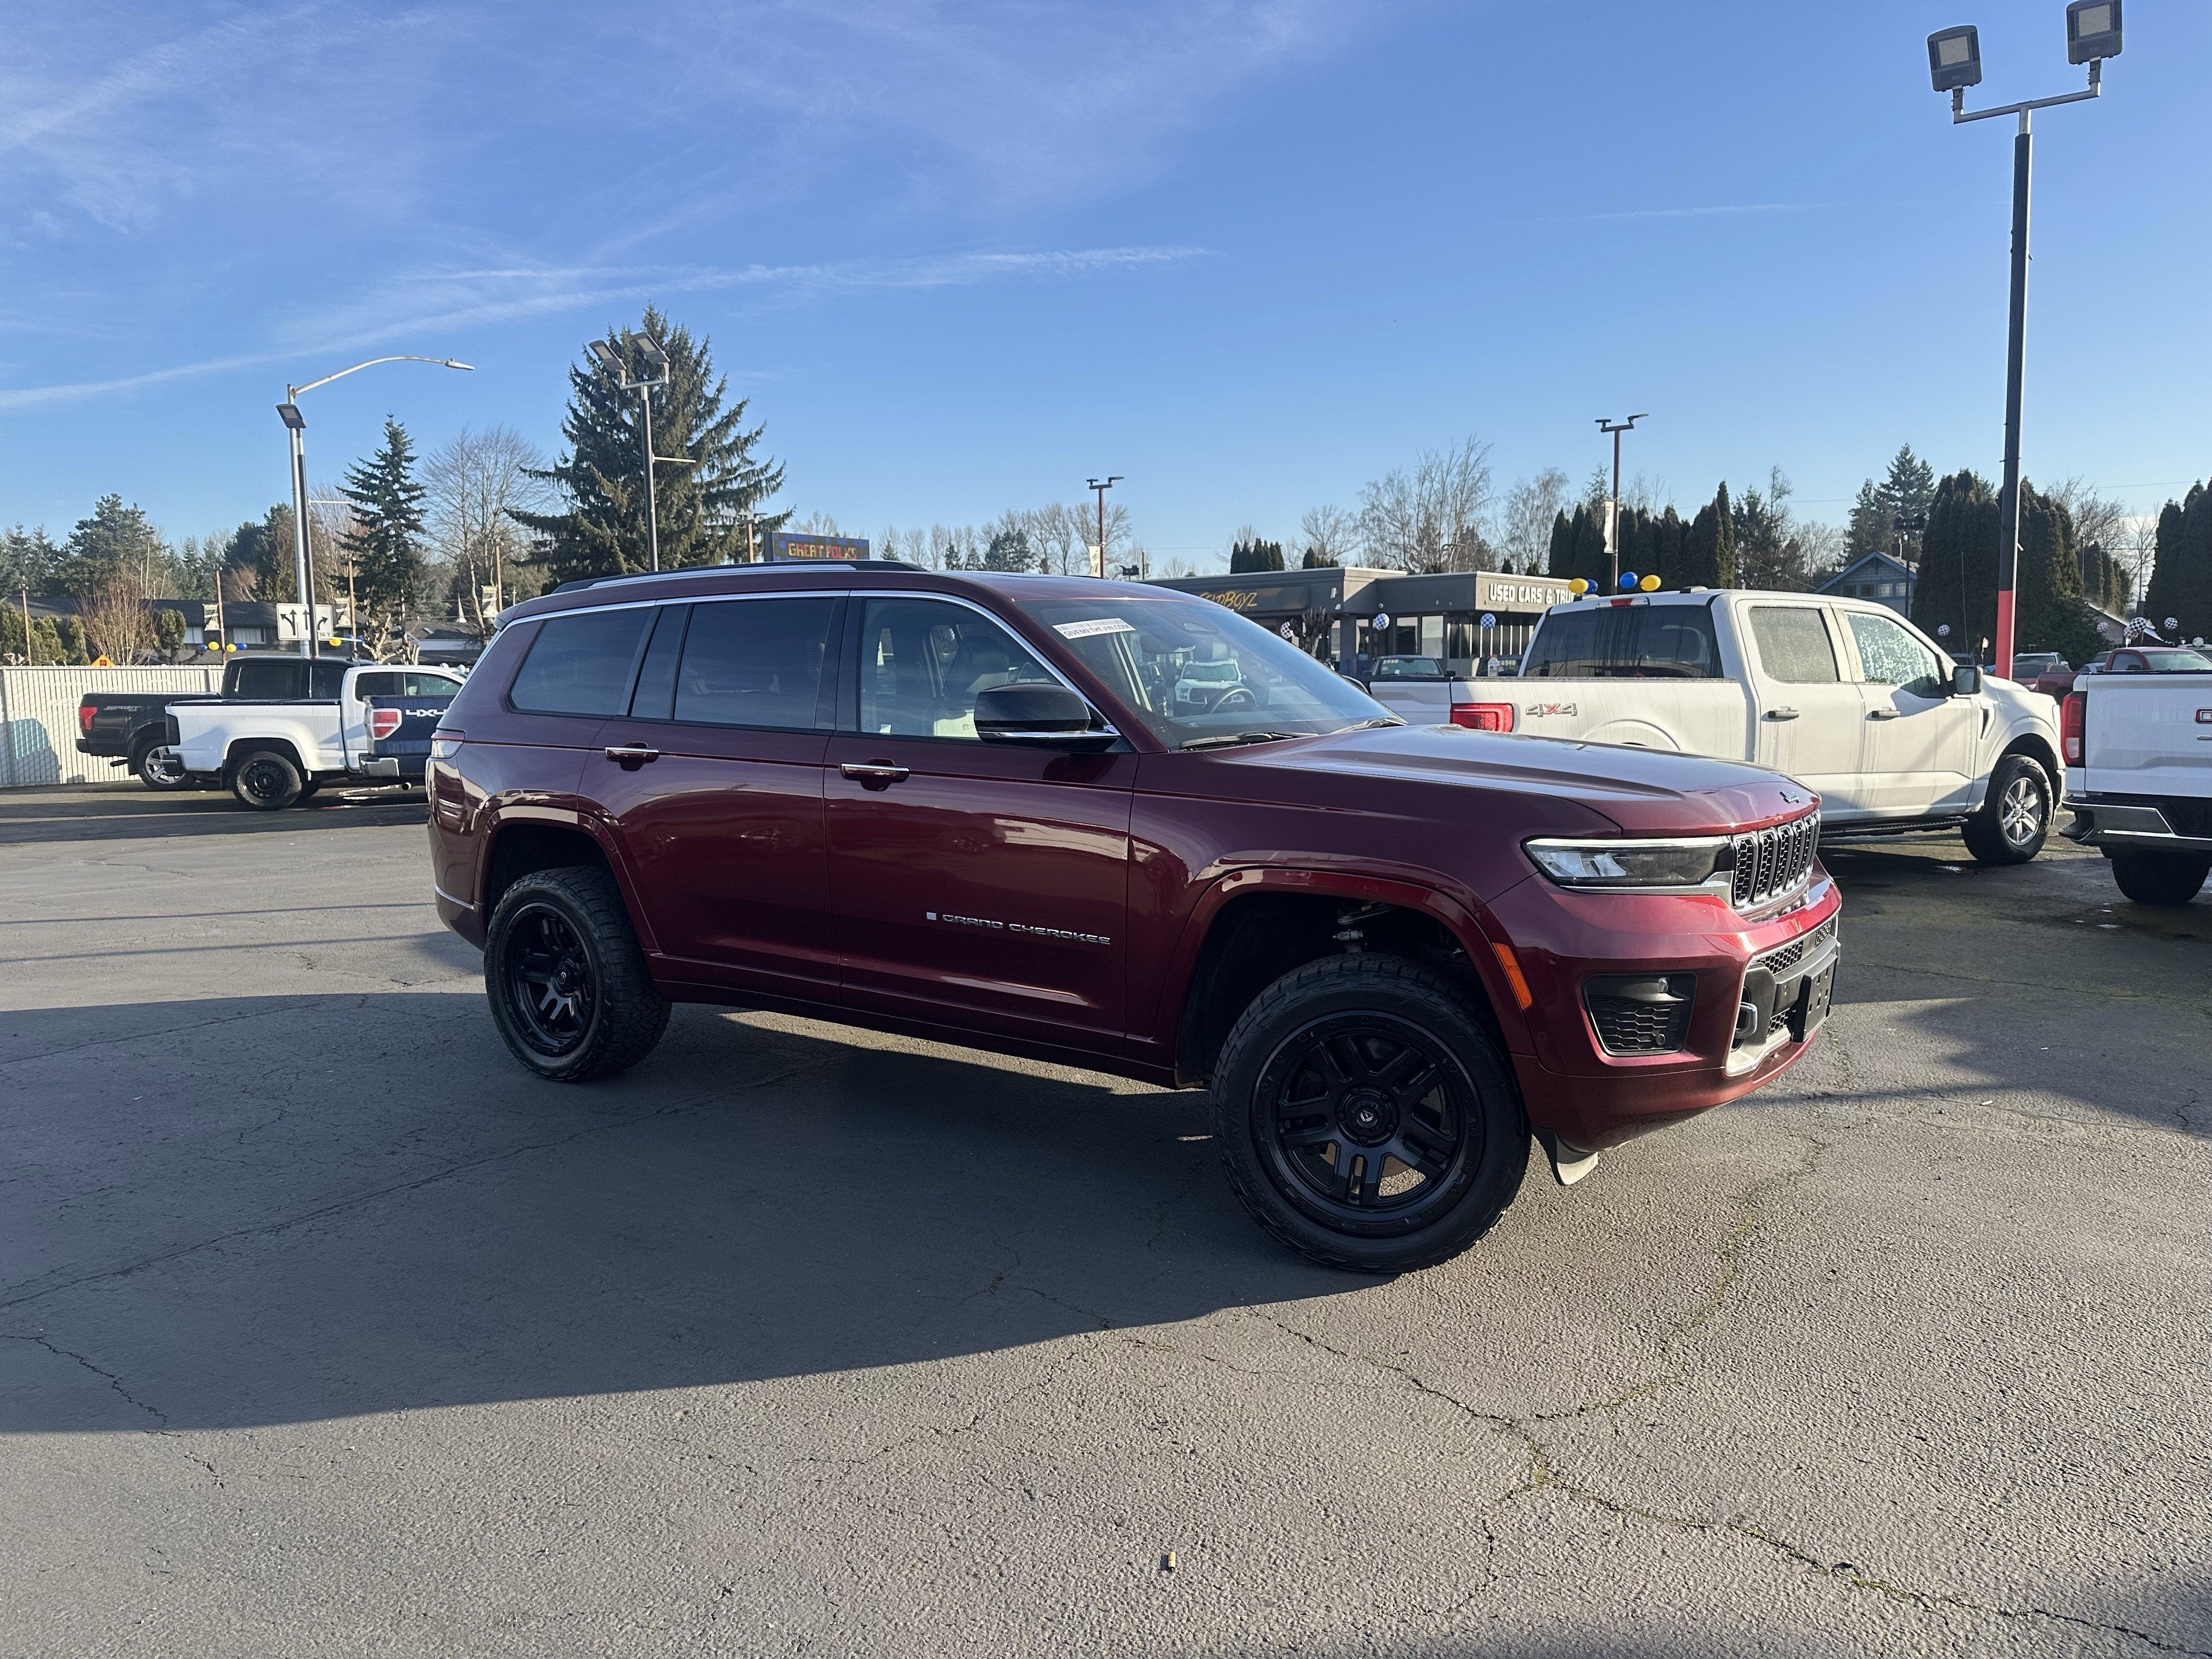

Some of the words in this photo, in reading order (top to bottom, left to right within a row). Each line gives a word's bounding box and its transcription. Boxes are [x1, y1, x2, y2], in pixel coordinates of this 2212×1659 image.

[788, 543, 823, 558] GREAT
[826, 546, 856, 560] FOLKS
[1489, 583, 1515, 602] USED
[1518, 586, 1542, 603] CARS
[1545, 588, 1553, 605] &
[942, 913, 1004, 929] GRAND
[1008, 923, 1111, 945] CHEROKEE
